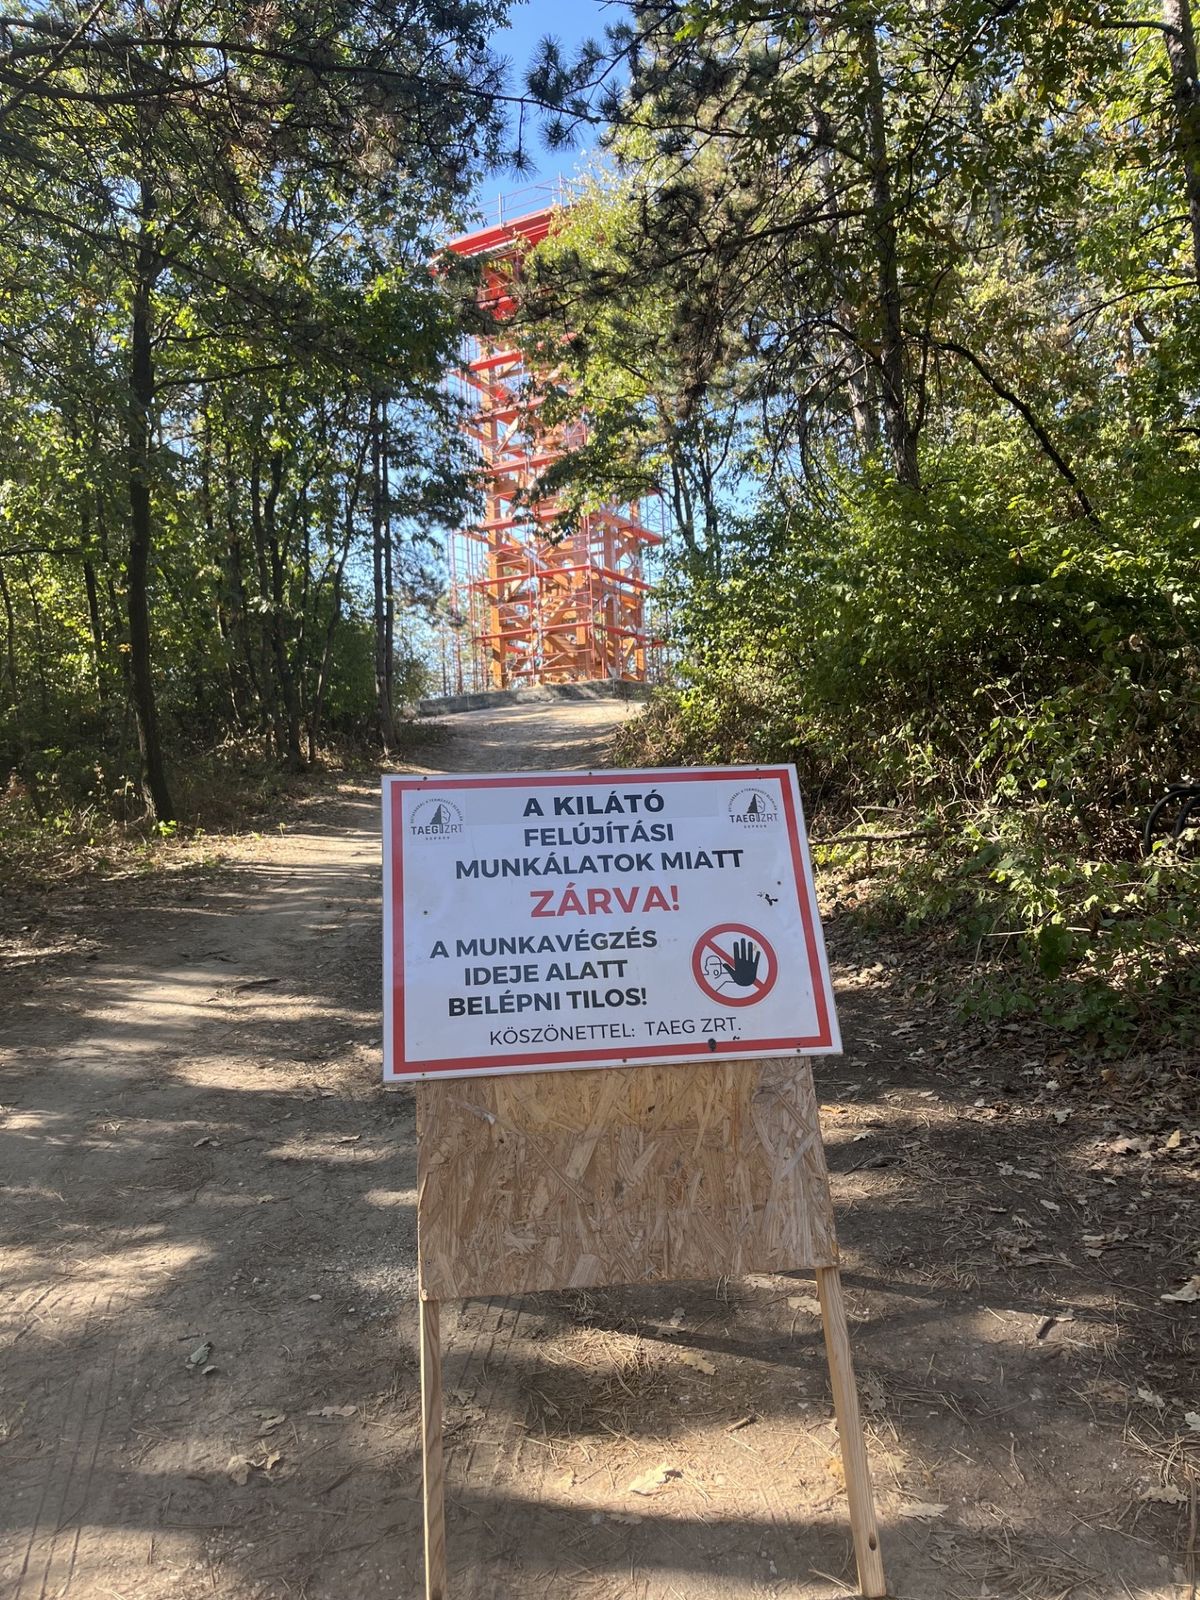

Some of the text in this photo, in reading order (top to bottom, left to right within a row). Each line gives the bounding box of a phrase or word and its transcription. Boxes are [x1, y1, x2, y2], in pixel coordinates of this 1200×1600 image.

[522, 788, 665, 818] A KILÁTÓ
[411, 824, 464, 835] TAEG ZRT
[729, 813, 778, 823] TAEG ZRT
[523, 819, 675, 847] FELÚJÍTÁSI
[456, 849, 744, 879] MUNKÁLATOK MIATT
[530, 882, 681, 918] ZÁRVA!
[429, 926, 659, 959] A MUNKAVÉGZÉS
[464, 960, 629, 986] IDEJE ALATT
[448, 987, 648, 1017] BELÉPNI TILOS!
[489, 1017, 743, 1046] KÖSZÖNETTEL: TAEG ZRT.
